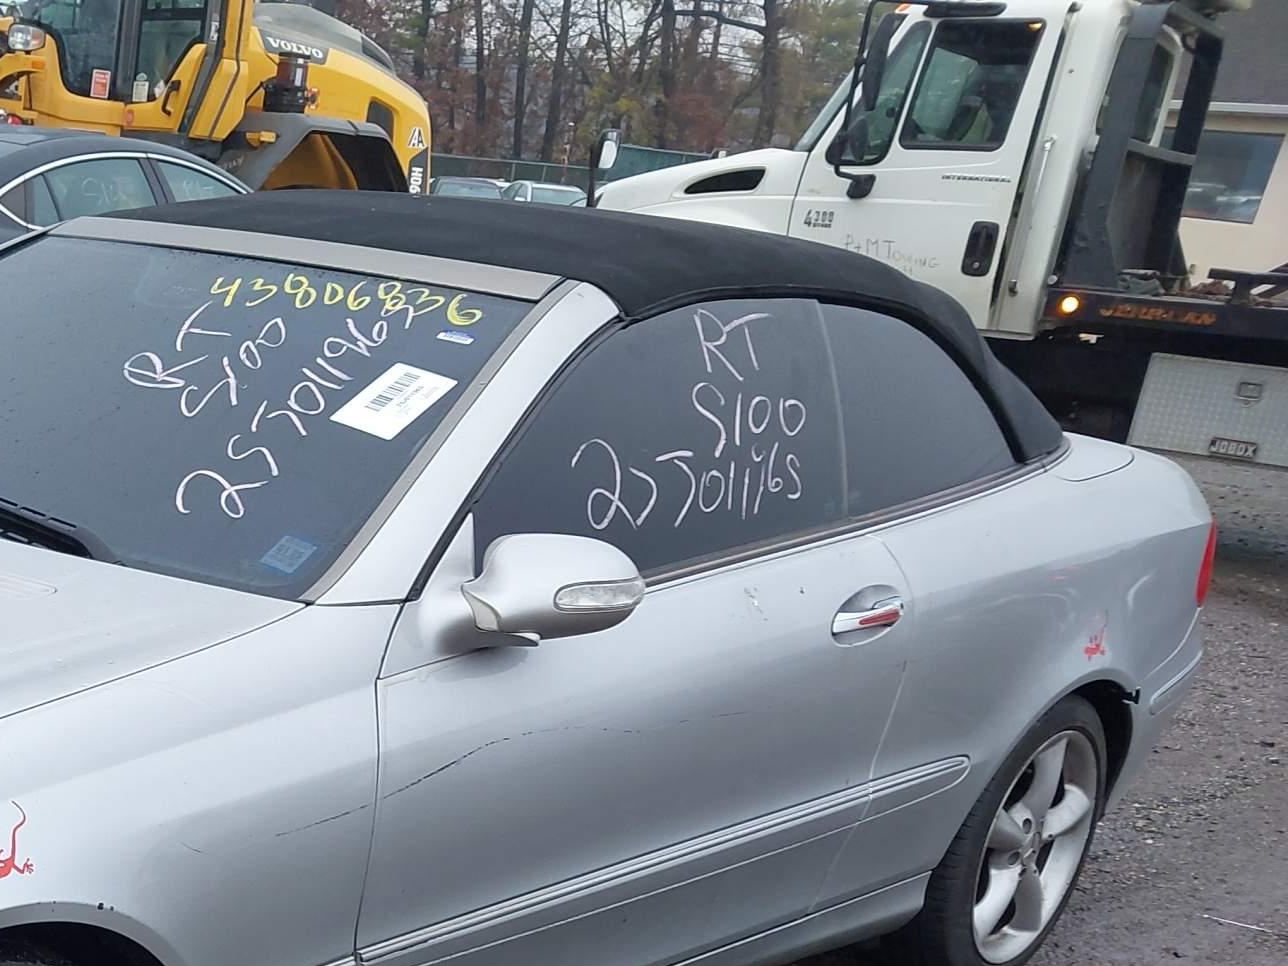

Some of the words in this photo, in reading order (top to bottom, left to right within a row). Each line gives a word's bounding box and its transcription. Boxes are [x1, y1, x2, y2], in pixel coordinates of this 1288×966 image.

[266, 37, 324, 59] VOLVO
[409, 166, 424, 199] 90H
[941, 175, 1011, 183] INTERNATIONAL
[803, 208, 835, 228] 4300
[210, 273, 484, 326] 43806836
[693, 308, 774, 381] RT
[691, 381, 807, 458] S100
[1211, 439, 1257, 458] JOBOX
